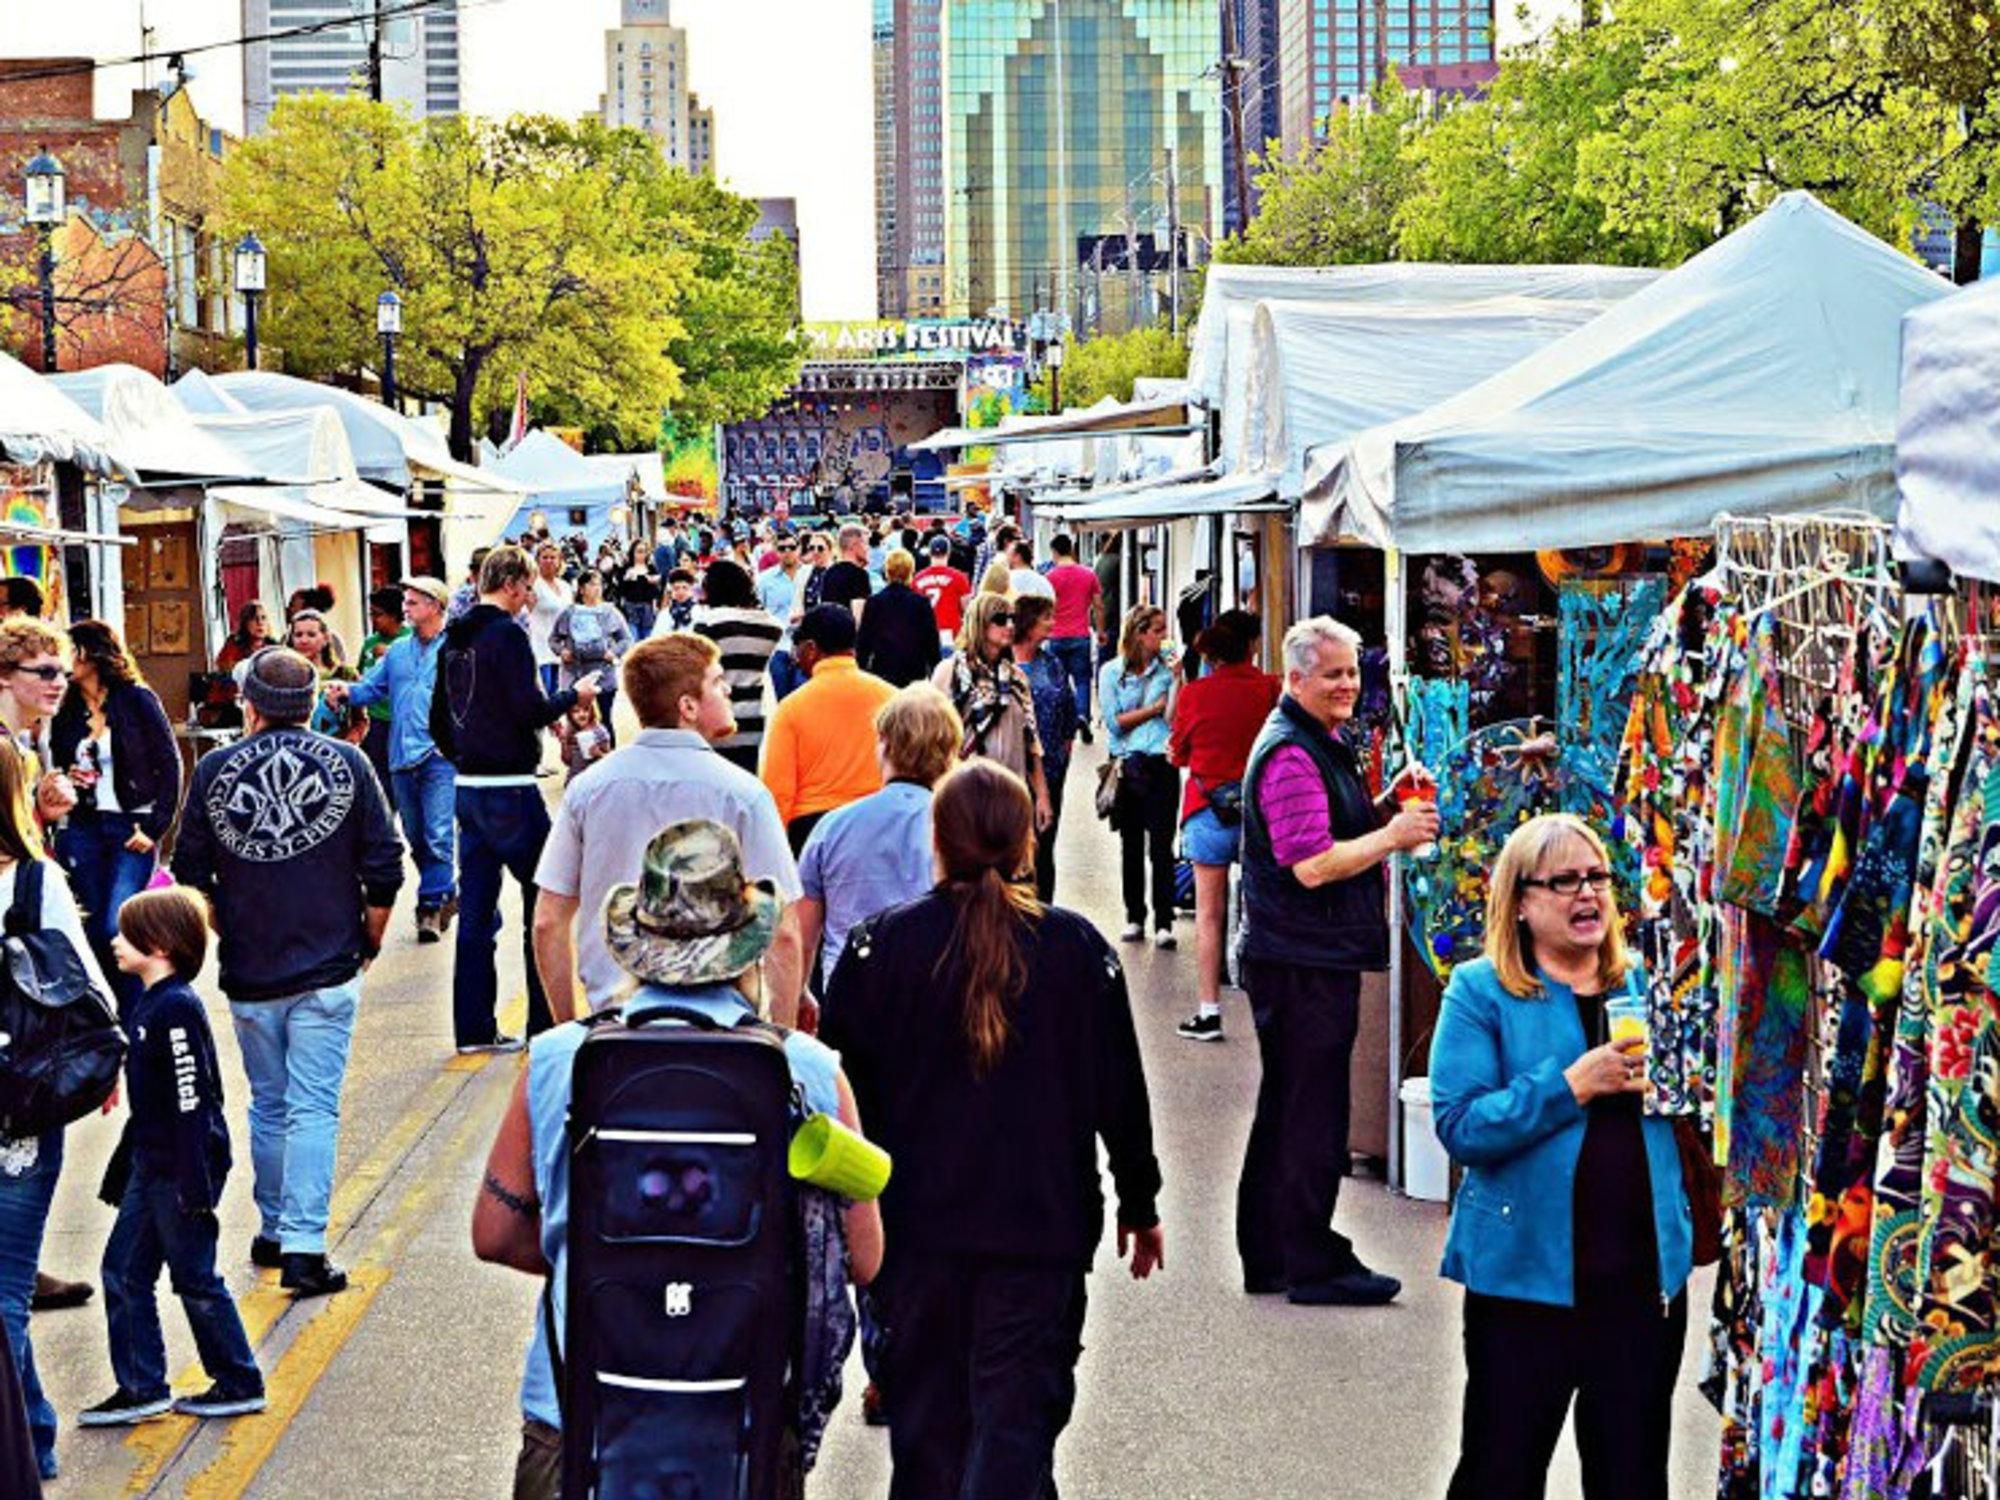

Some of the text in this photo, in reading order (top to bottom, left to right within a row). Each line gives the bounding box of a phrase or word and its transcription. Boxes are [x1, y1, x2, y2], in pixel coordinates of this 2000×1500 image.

[836, 324, 897, 349] ARTS
[906, 322, 1015, 349] FESTIVAL
[926, 587, 941, 608] 7
[220, 733, 347, 784] AFFLICTION
[207, 795, 266, 858] GEORGES
[169, 1027, 200, 1112] a&fitch
